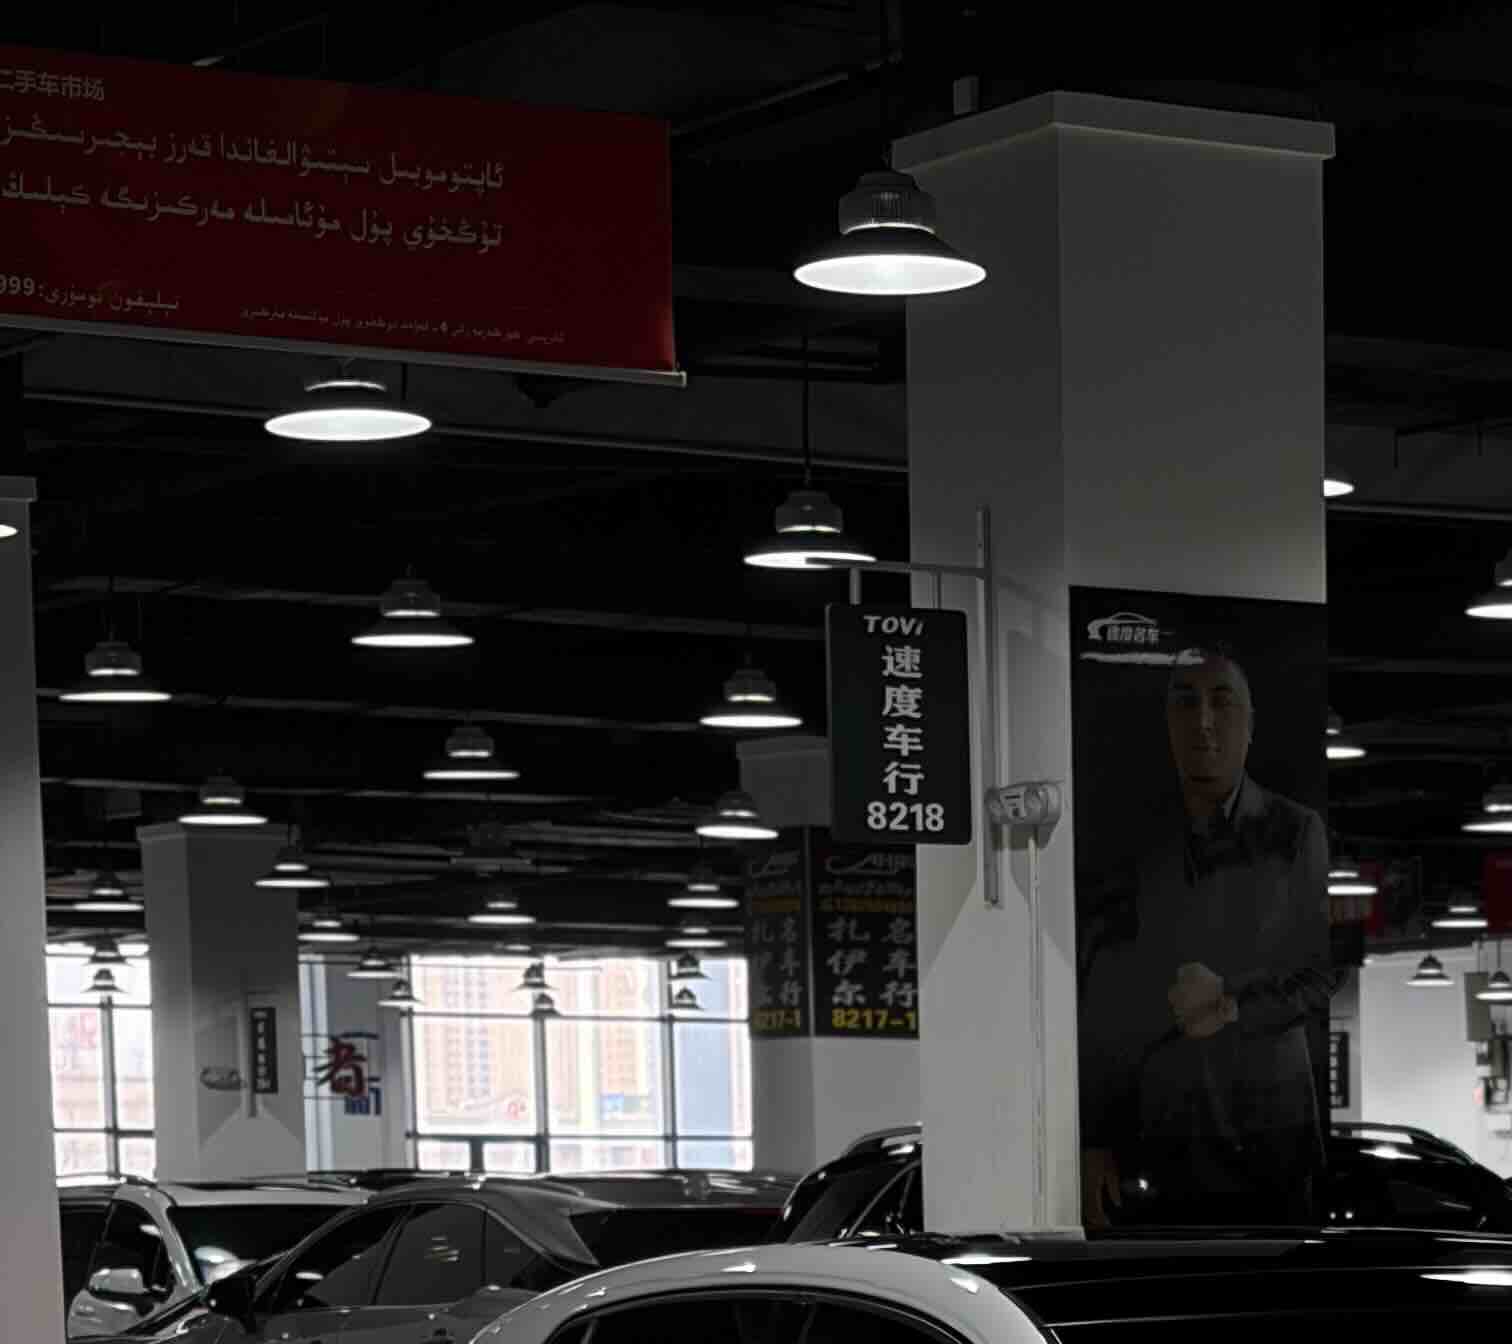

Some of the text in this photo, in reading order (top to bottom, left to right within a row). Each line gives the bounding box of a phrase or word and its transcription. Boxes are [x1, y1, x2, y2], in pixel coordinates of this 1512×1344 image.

[0, 69, 105, 101] 二手车市场
[881, 645, 924, 795] 速度车行
[867, 801, 945, 832] 8218
